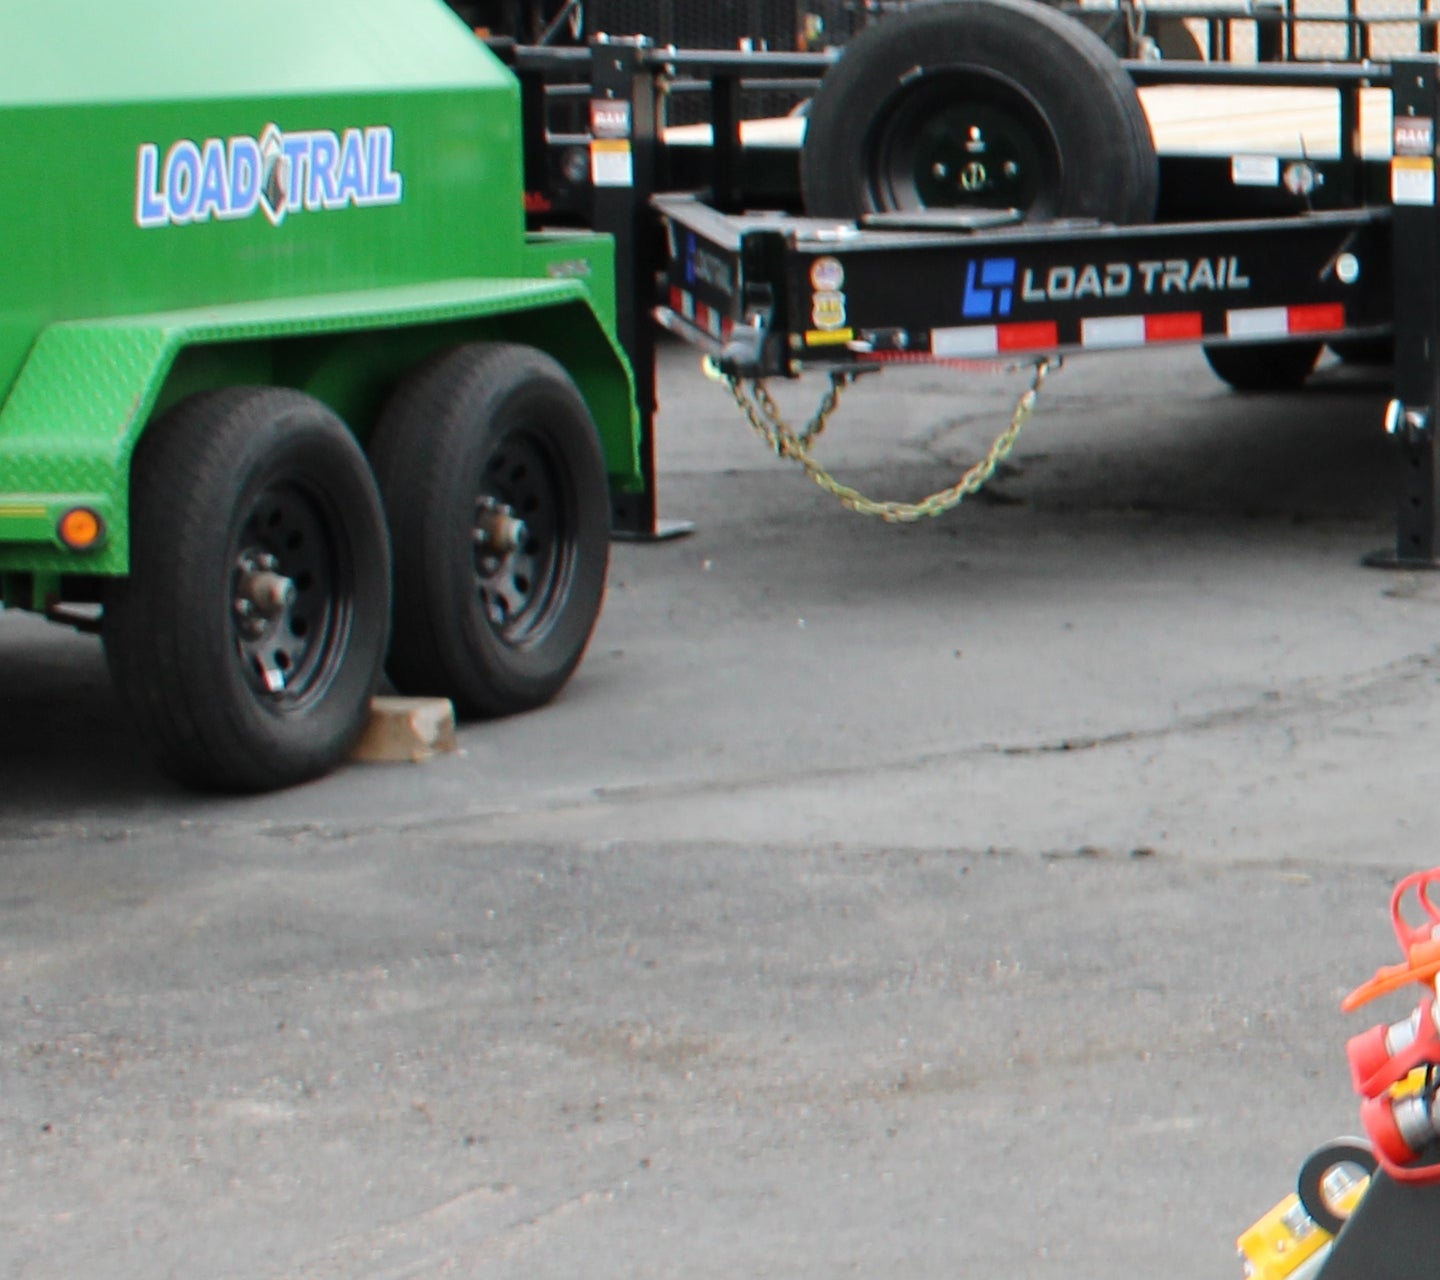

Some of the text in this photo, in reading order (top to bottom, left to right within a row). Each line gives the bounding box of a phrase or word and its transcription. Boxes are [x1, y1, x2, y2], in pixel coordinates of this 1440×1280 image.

[136, 125, 402, 228] LOAD TRAIL
[1021, 264, 1132, 302] LOAD
[1138, 256, 1250, 294] TRAIL
